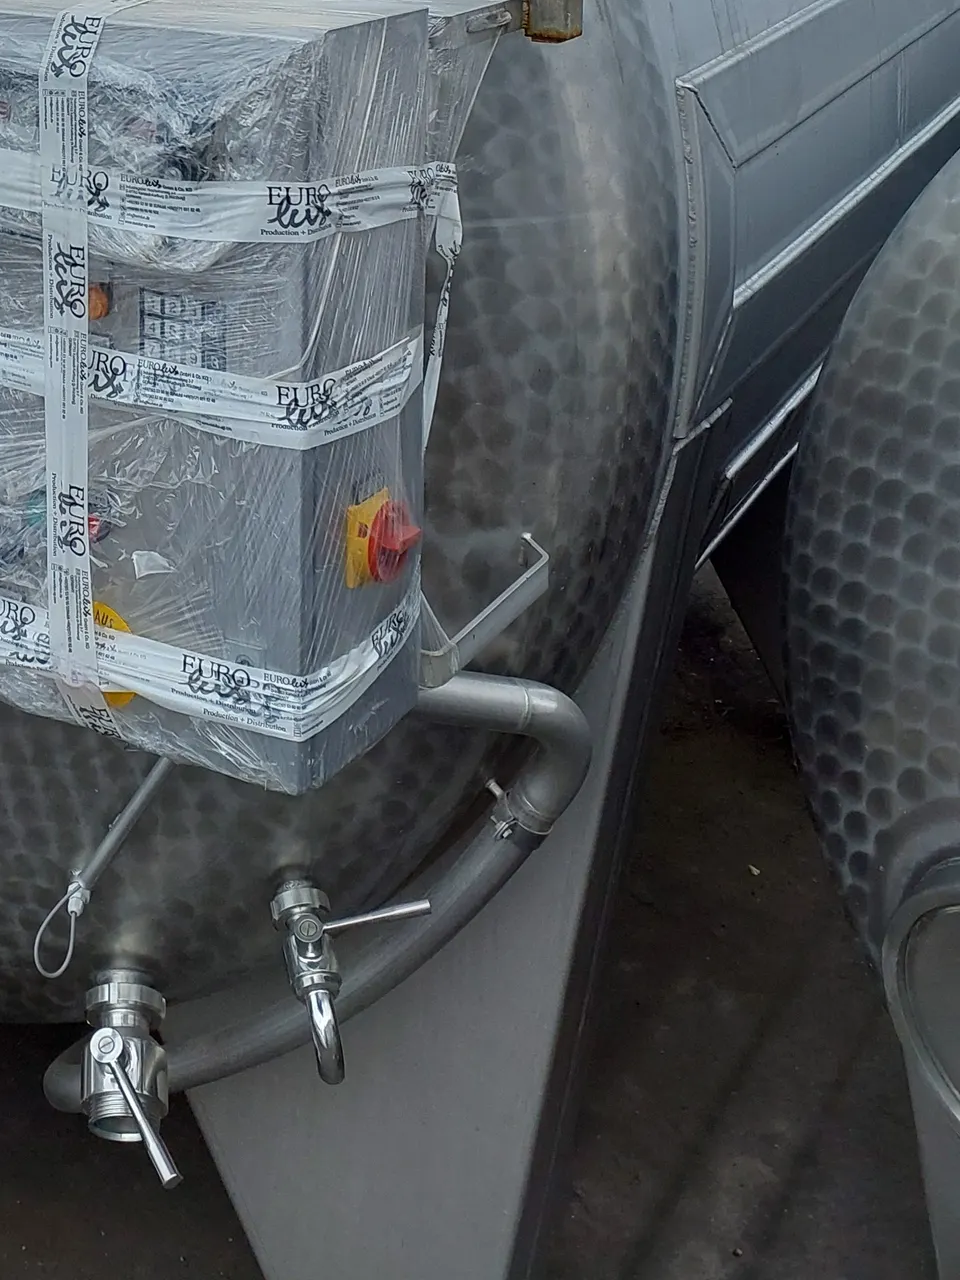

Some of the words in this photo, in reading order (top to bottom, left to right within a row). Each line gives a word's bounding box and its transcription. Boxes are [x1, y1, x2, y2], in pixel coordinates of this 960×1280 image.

[69, 15, 103, 78] EURO
[267, 184, 331, 206] EURO
[260, 227, 299, 237] Production
[69, 244, 86, 319] EURO
[276, 378, 336, 407] EURO
[68, 484, 86, 557] EURO
[180, 653, 251, 687] EURO
[263, 672, 309, 688] EUROlux
[203, 708, 238, 722] Production
[246, 717, 287, 732] Distribution
